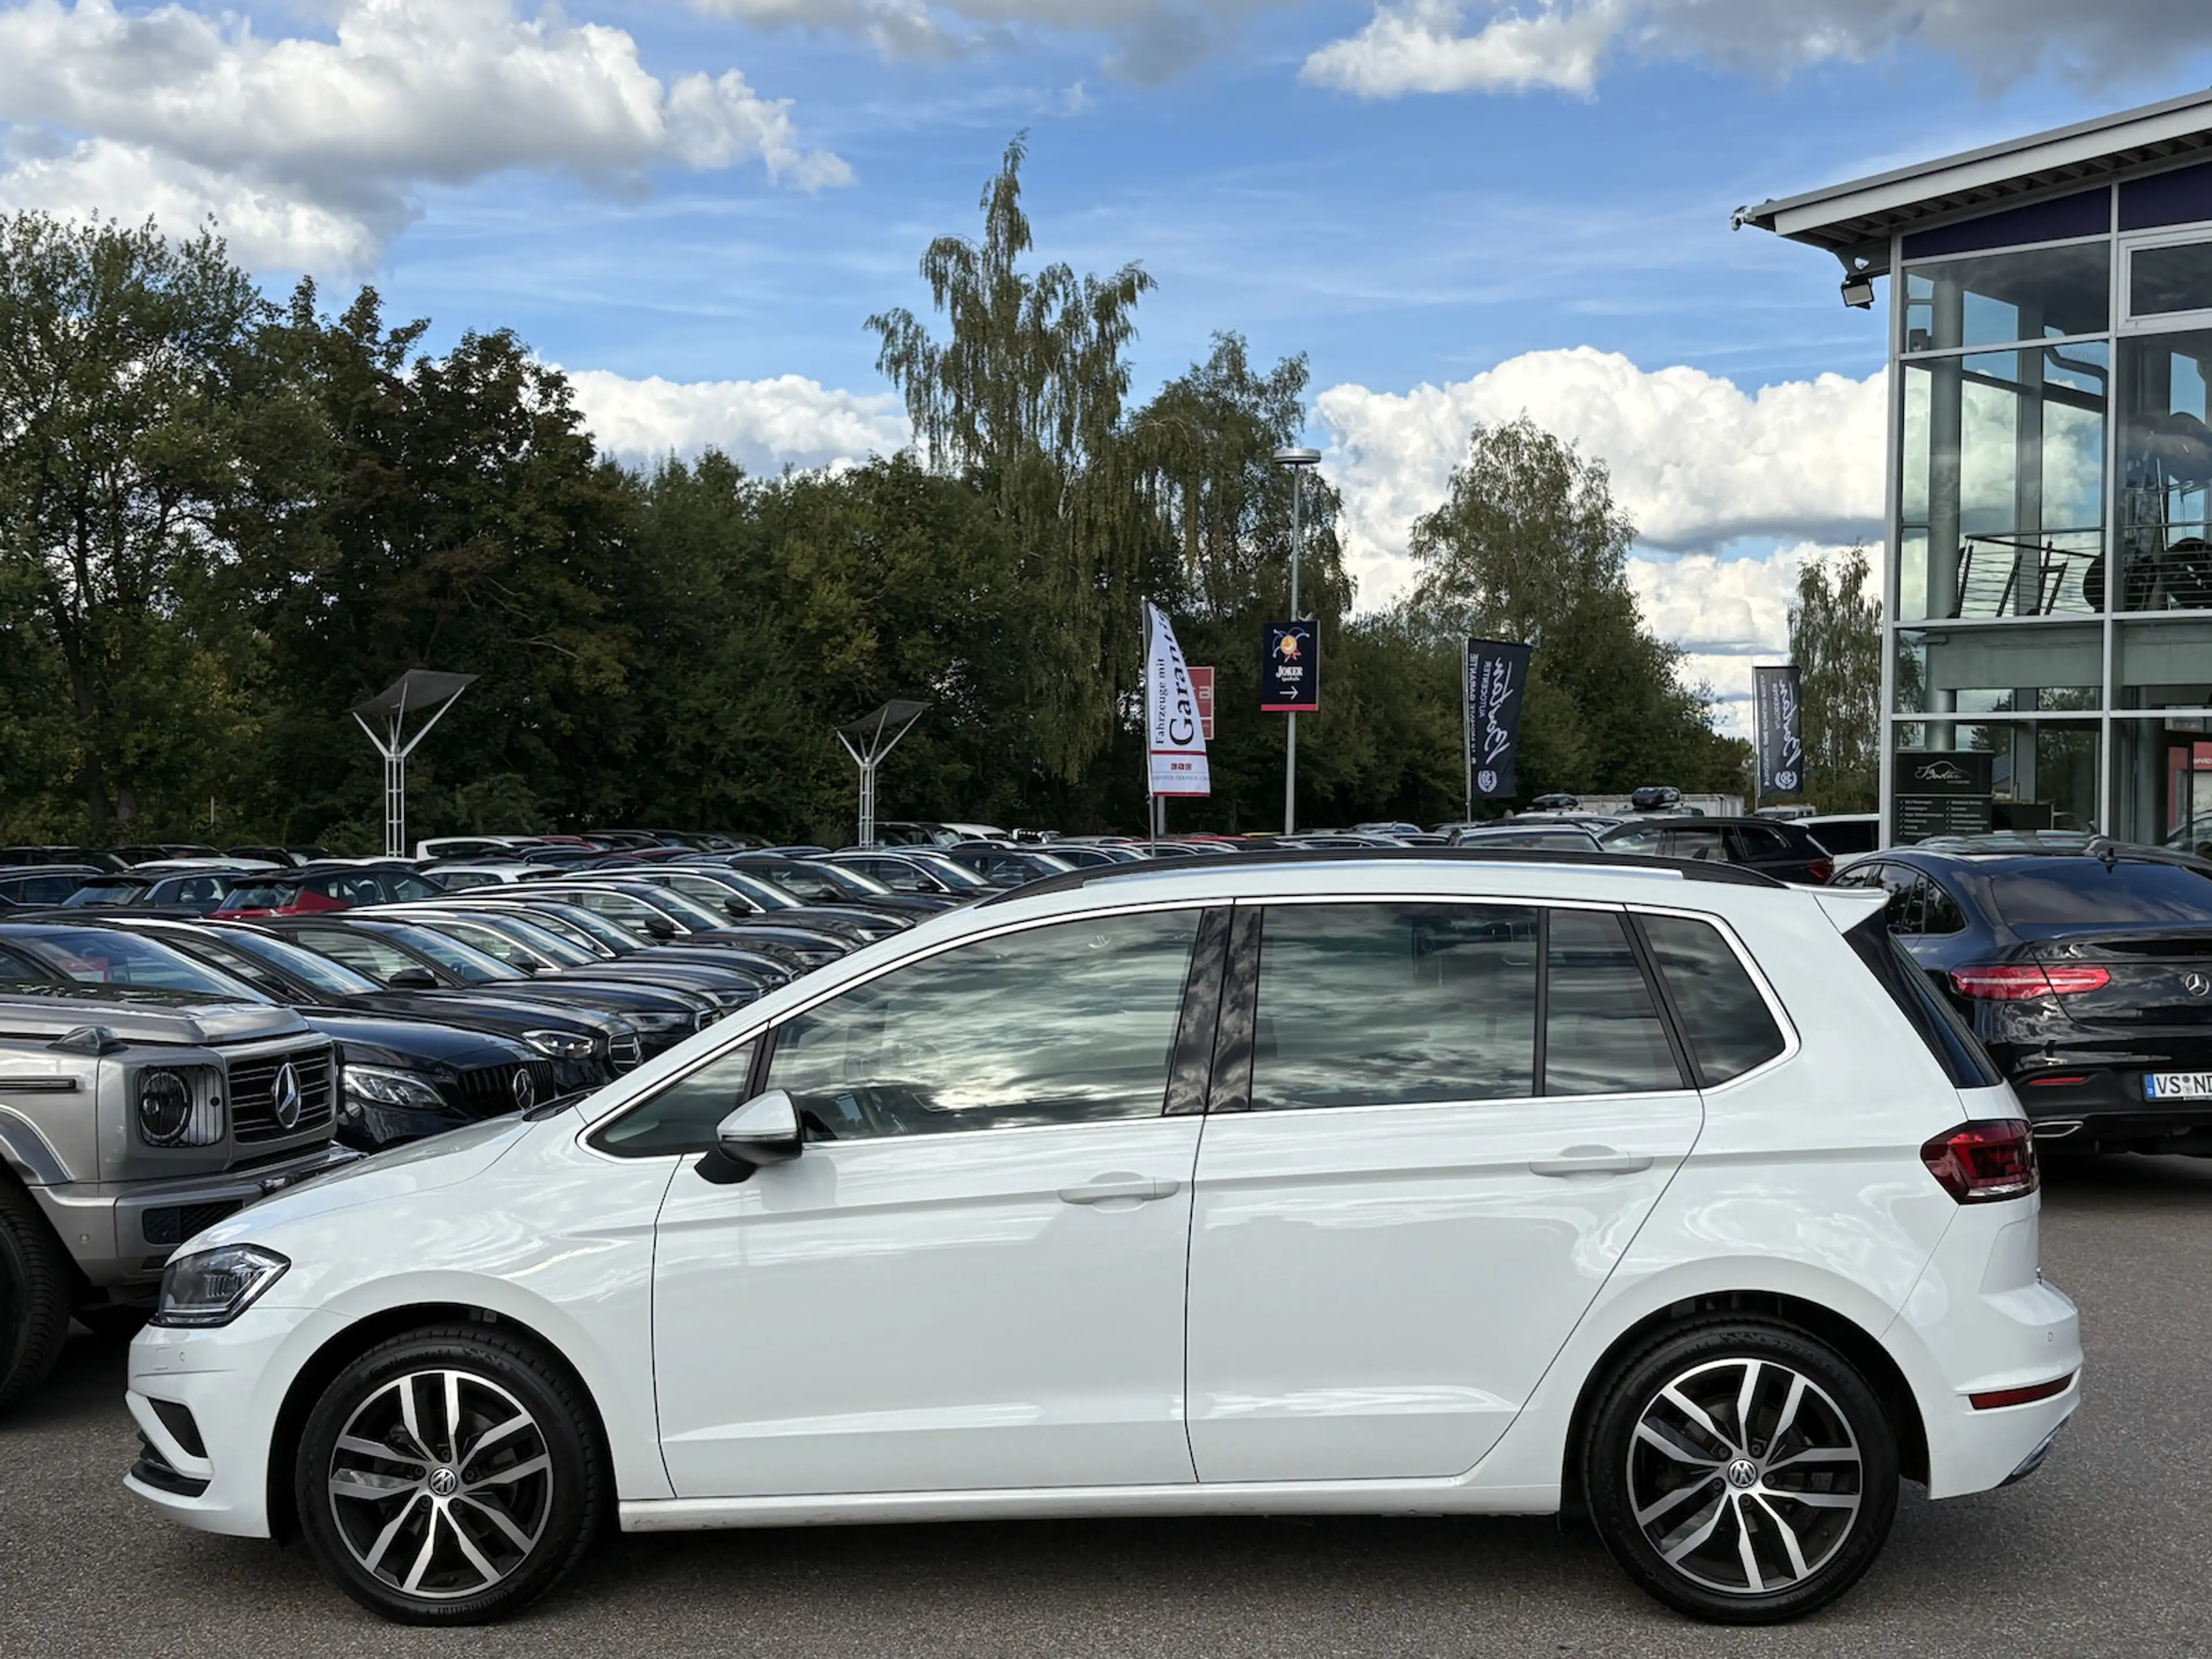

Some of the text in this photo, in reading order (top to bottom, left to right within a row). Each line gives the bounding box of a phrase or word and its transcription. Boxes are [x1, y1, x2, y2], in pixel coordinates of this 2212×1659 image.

[1156, 658, 1169, 745] Fahrzeuge mit
[2156, 1075, 2181, 1094] VS
